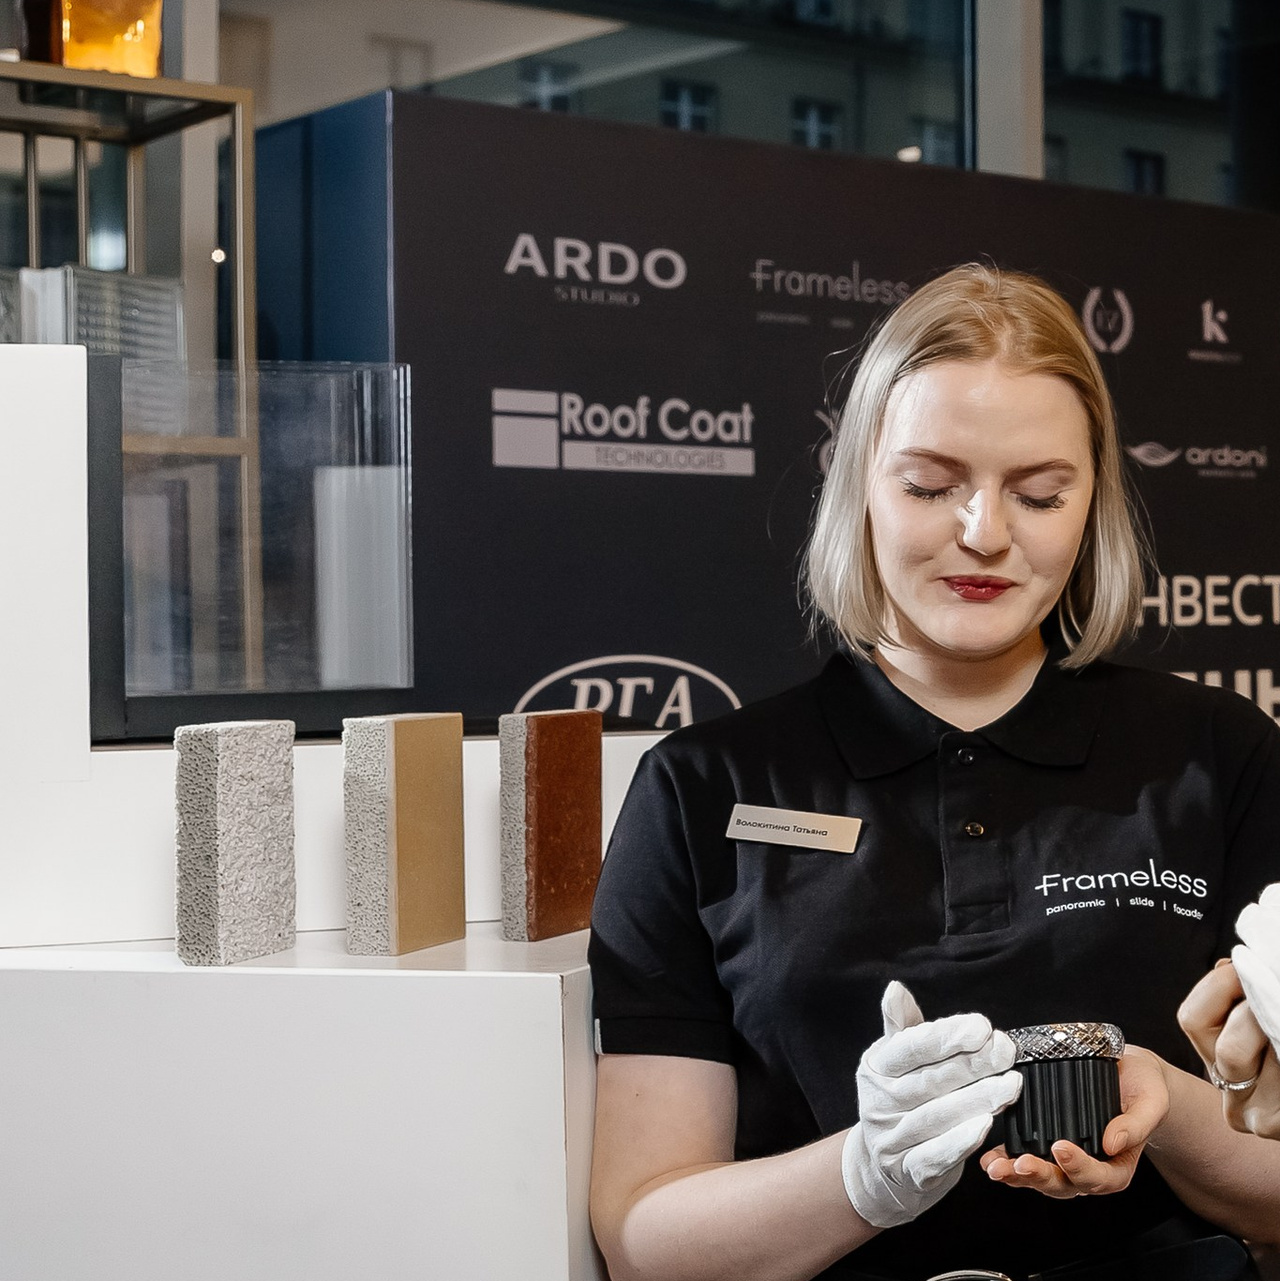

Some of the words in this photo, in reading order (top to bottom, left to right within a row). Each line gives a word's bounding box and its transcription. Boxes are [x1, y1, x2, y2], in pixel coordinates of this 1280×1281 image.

[504, 232, 688, 289] ARDO
[751, 258, 911, 306] Frameless
[560, 391, 651, 439] Roof
[657, 397, 755, 444] Coat
[736, 818, 790, 832] Волокитина
[793, 825, 828, 836] Татьяна
[1034, 857, 1208, 898] Frameless
[1045, 898, 1106, 916] panoramic
[1129, 896, 1155, 908] slide
